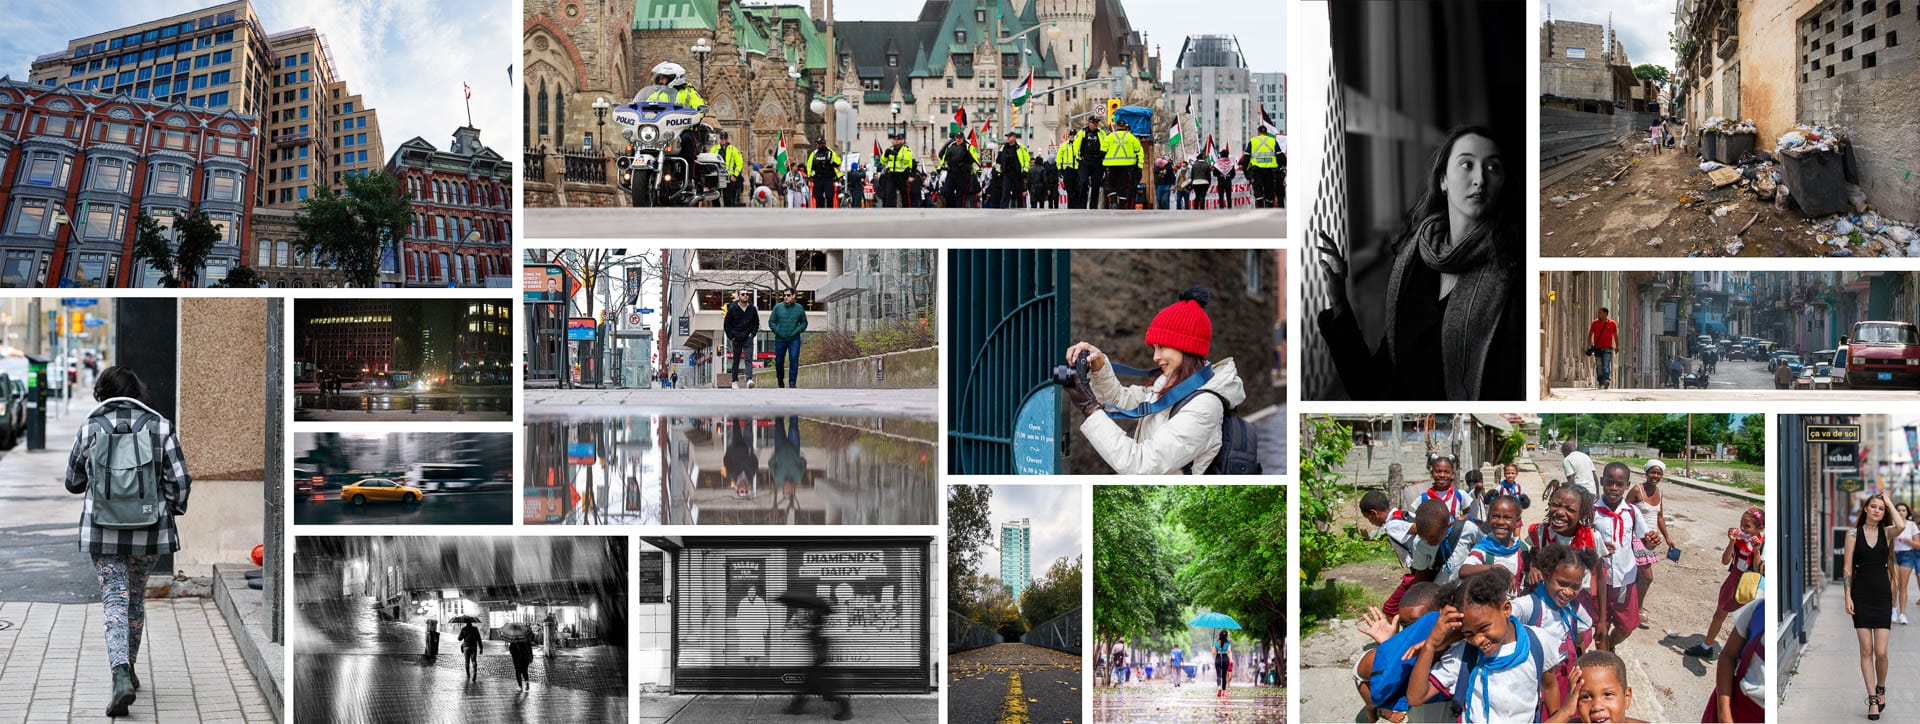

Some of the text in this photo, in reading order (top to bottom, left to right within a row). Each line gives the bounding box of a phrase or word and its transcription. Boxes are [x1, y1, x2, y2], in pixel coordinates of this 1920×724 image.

[666, 118, 692, 126] POLICE
[1829, 453, 1853, 462] schad
[821, 567, 862, 576] DAIRY
